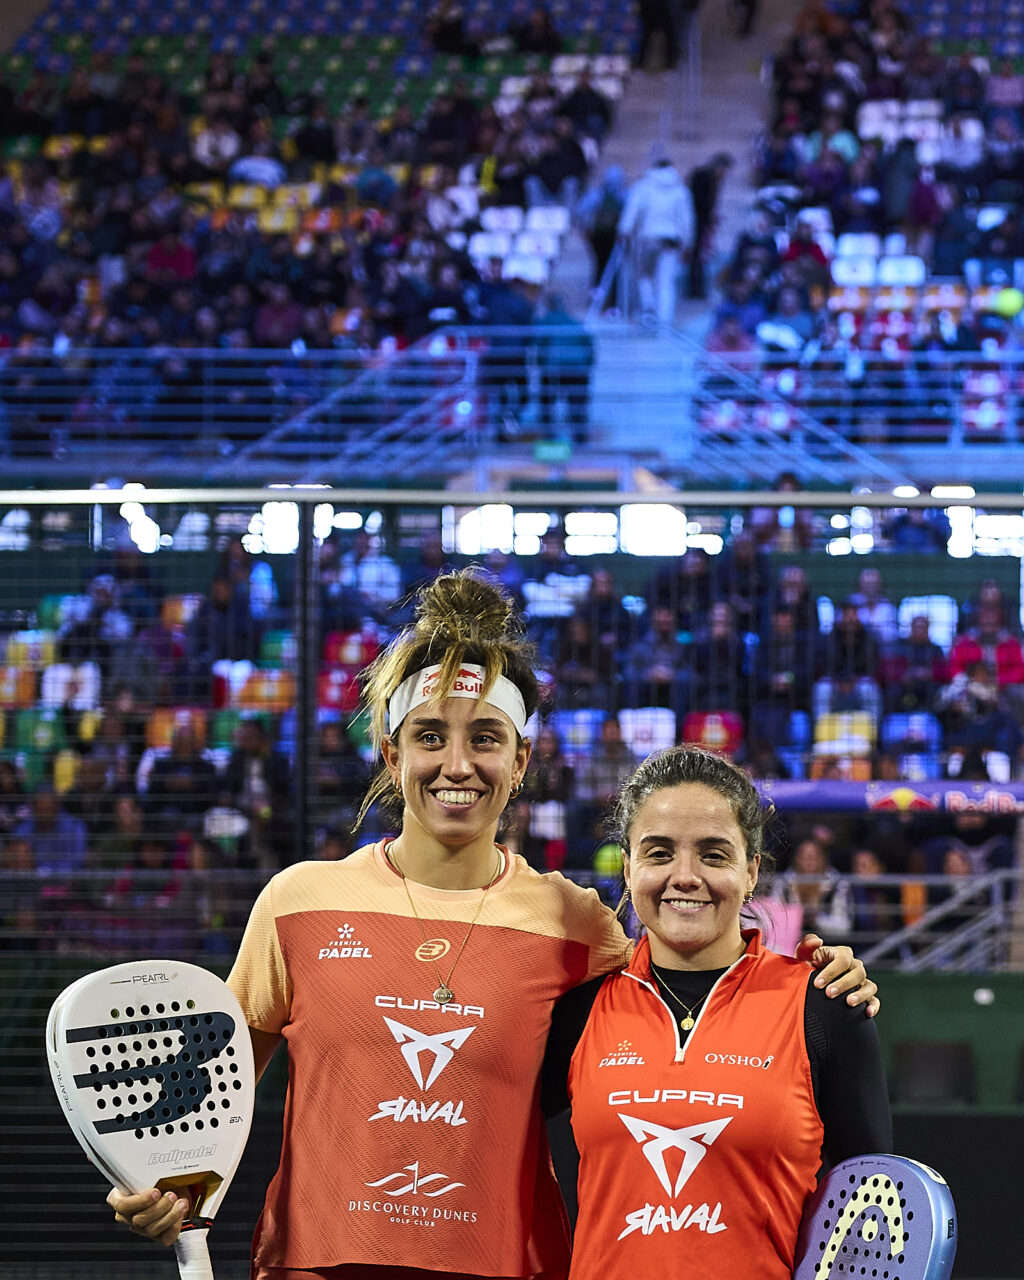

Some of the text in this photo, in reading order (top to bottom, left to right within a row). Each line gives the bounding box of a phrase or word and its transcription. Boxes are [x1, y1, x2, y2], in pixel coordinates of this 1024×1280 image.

[318, 947, 372, 960] PADEL
[132, 973, 169, 983] PEARL
[374, 995, 485, 1019] CUPRA
[598, 1056, 645, 1068] PADEL
[704, 1052, 762, 1068] OYSHO
[608, 1089, 744, 1109] CUPRA
[367, 1095, 468, 1126] RAVAL
[148, 1144, 217, 1165] Bullpadel
[349, 1200, 477, 1223] DISCOVERY DUNES
[389, 1216, 435, 1227] GOLF CLUB
[617, 1201, 728, 1241] RAVAL
